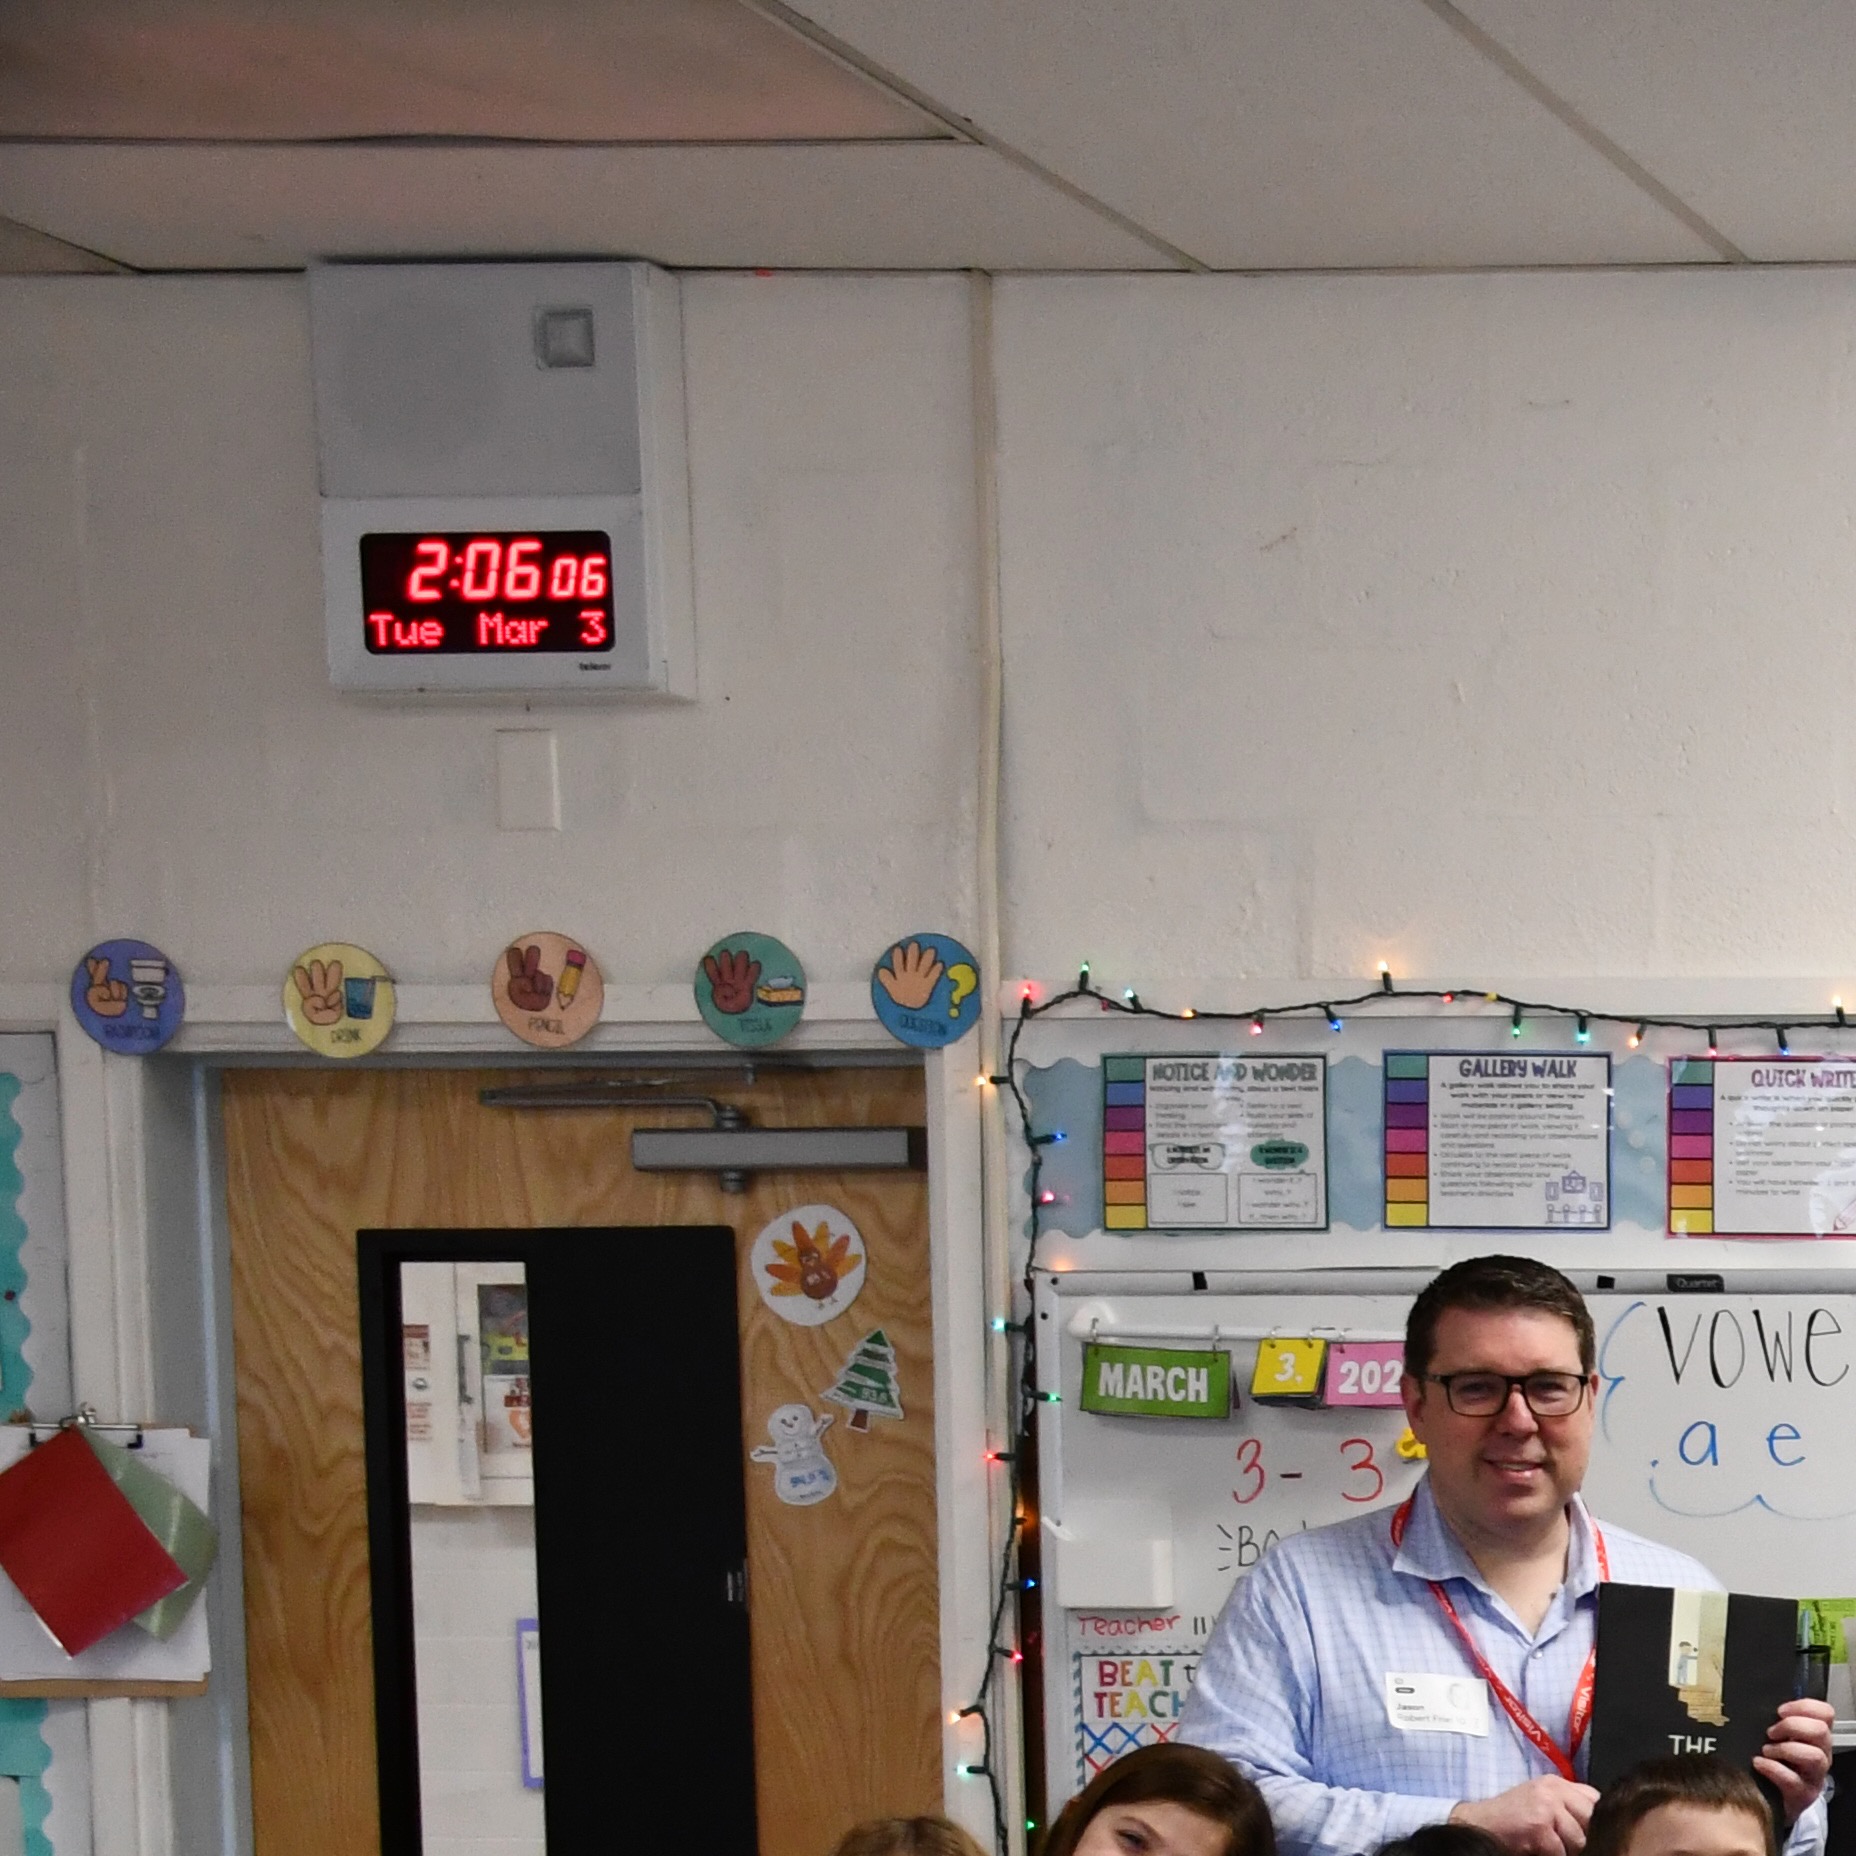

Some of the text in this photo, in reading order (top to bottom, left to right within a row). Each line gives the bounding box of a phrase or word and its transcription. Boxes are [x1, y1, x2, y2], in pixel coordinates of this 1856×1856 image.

[407, 537, 606, 602] 2:06 06
[369, 610, 606, 647] Tue Mar 3
[1153, 1063, 1209, 1081] NOTICE
[1252, 1063, 1318, 1082] WONDER
[1459, 1059, 1577, 1078] GALLERY WALK
[1751, 1069, 1856, 1088] QUICK WRITE
[1099, 1363, 1208, 1403] MARCH
[1338, 1360, 1402, 1394] 202
[1679, 1419, 1719, 1466] a
[1768, 1422, 1806, 1465] e
[1078, 1615, 1182, 1636] Teacher
[1099, 1660, 1174, 1687] BEAT
[1572, 1686, 1593, 1733] Visitor
